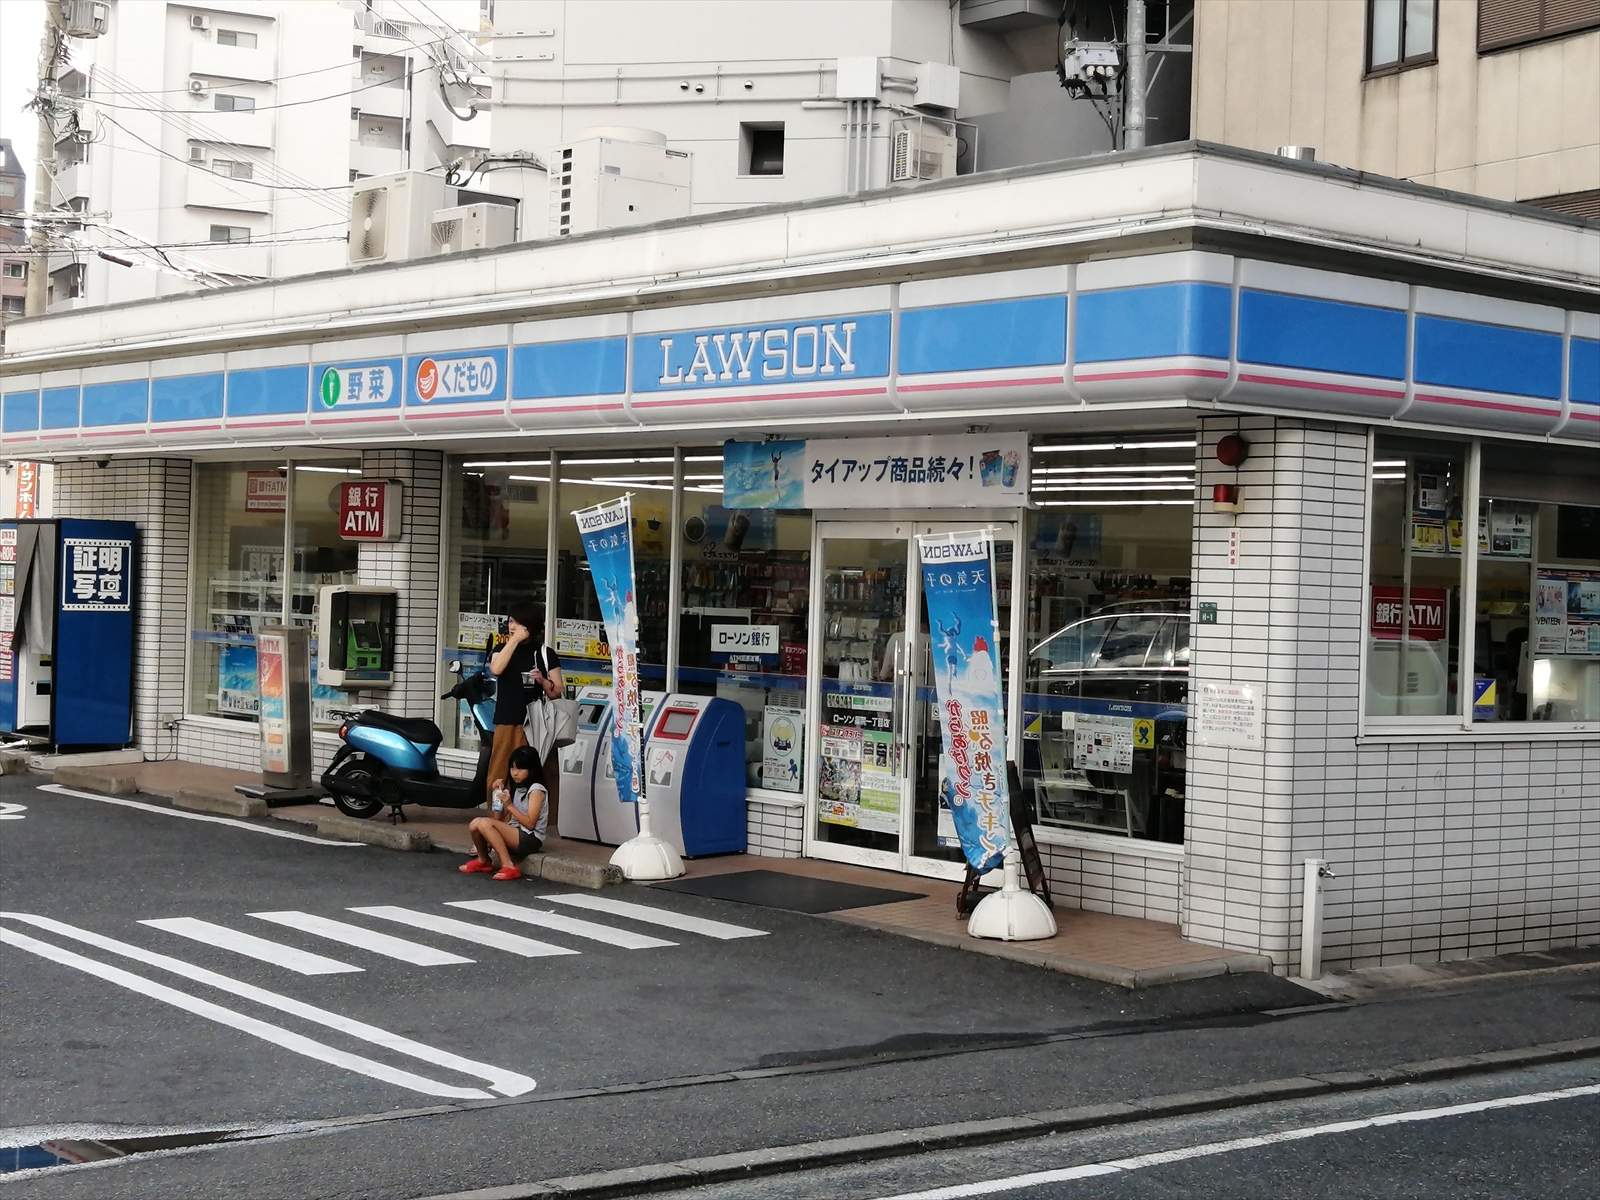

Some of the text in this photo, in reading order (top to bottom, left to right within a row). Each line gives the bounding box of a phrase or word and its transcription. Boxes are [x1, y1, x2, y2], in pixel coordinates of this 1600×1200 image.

[659, 321, 857, 386] LAWSON
[348, 369, 385, 400] 野菜
[441, 361, 493, 394] くだもの
[811, 455, 975, 484] タイアップ商品続々！
[348, 486, 379, 508] 銀行
[344, 510, 380, 532] ATM
[73, 546, 122, 572] 証明
[72, 573, 122, 600] 写真
[1375, 602, 1441, 626] 銀行ATM
[719, 631, 771, 647] ローソン銀行
